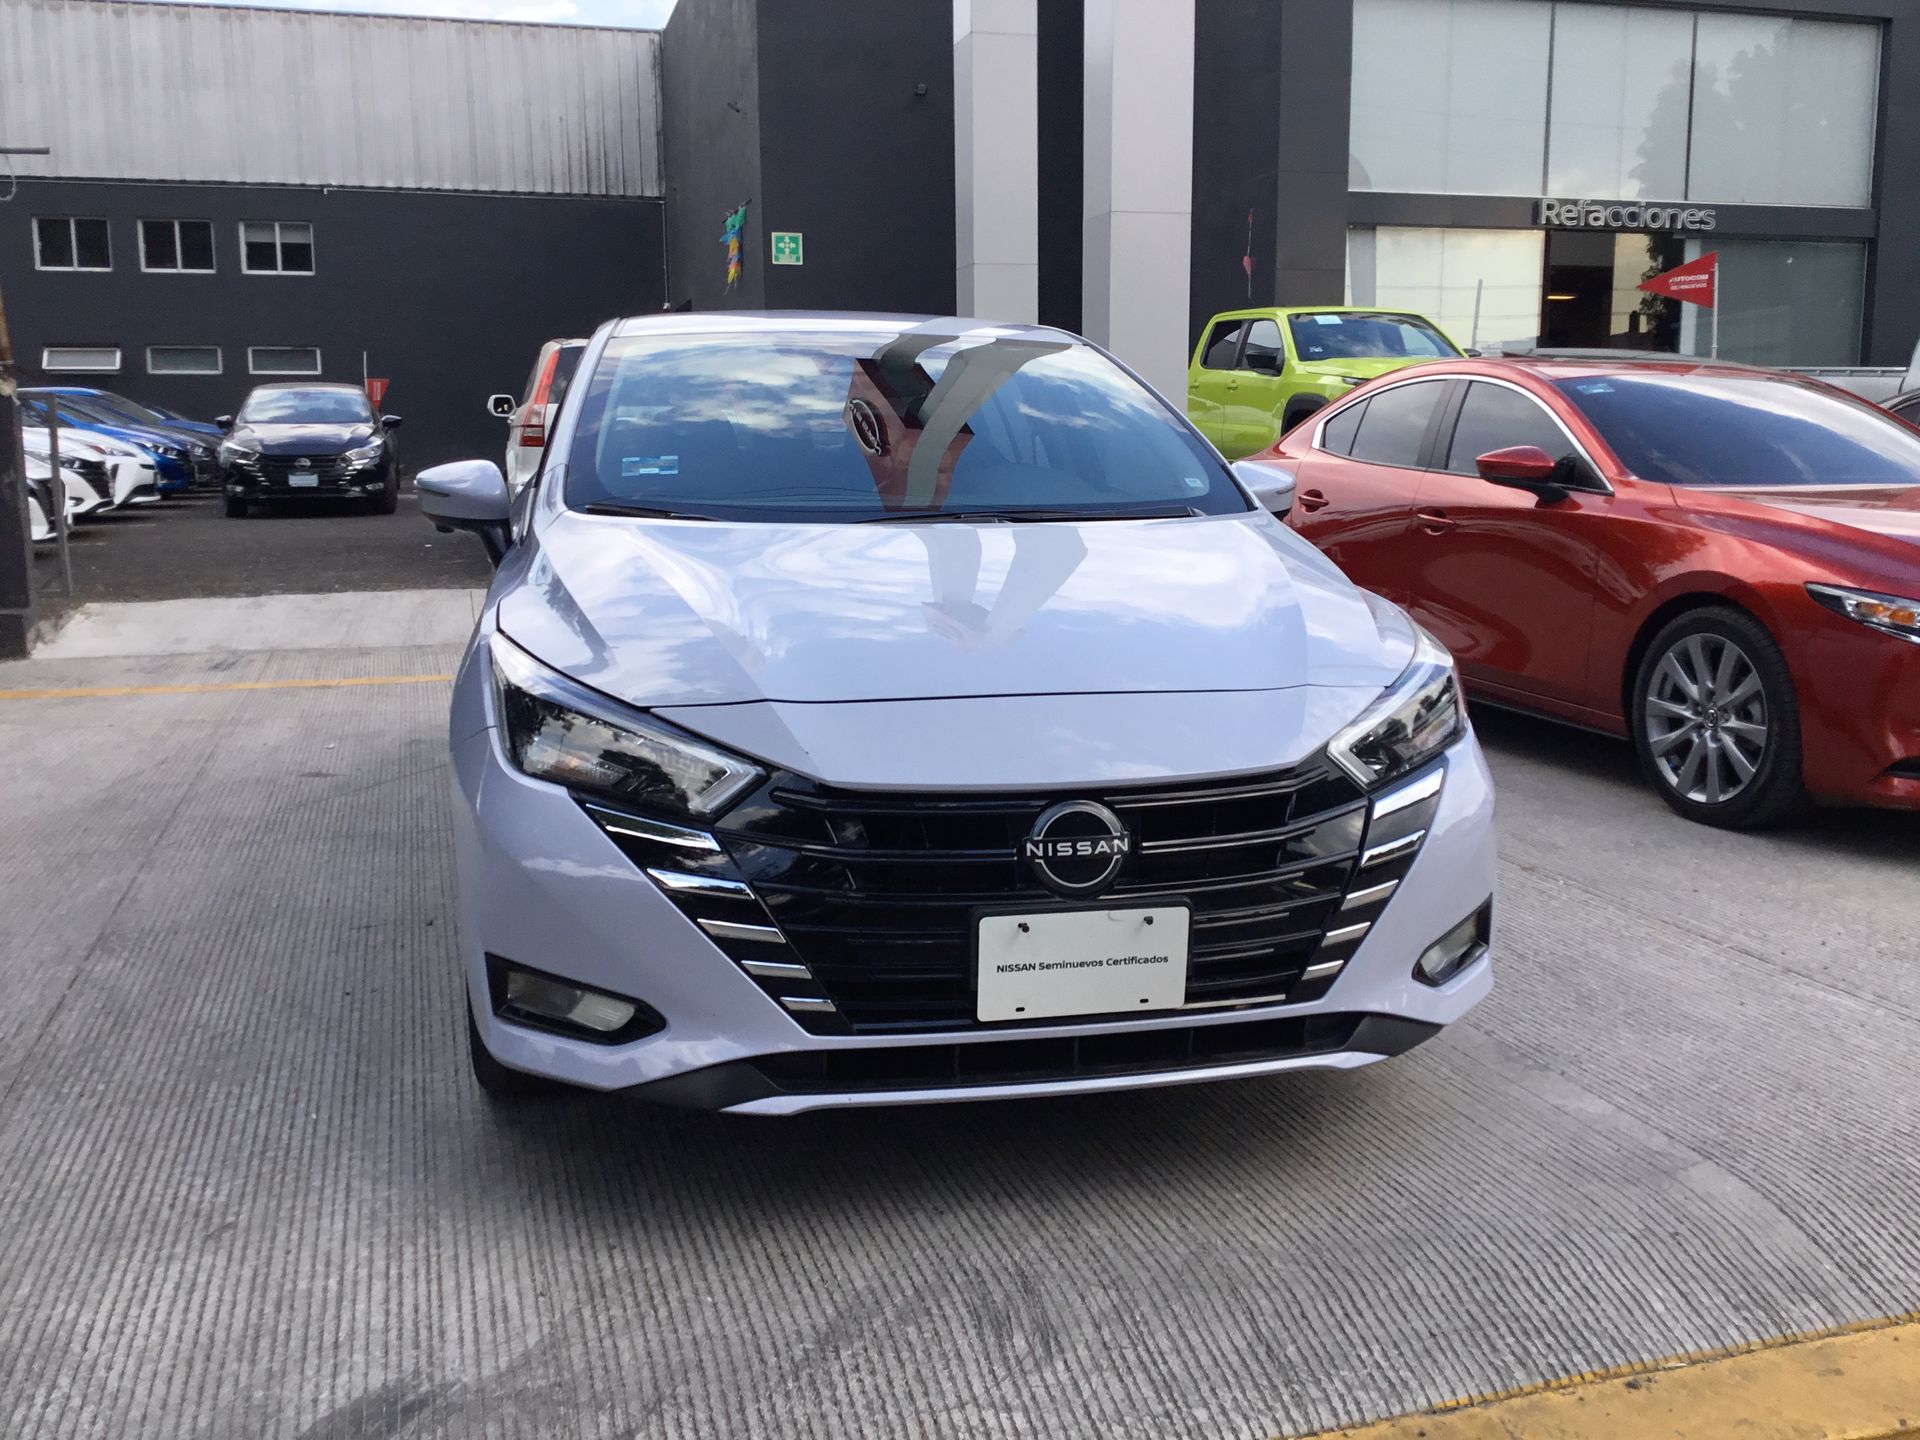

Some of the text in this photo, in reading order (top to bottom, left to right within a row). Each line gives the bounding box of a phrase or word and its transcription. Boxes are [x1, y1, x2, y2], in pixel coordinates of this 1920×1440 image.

[1540, 199, 1716, 230] Refacciones
[1026, 838, 1129, 857] NISSAN
[996, 955, 1169, 973] NISSAN Seminuevos Certificados
